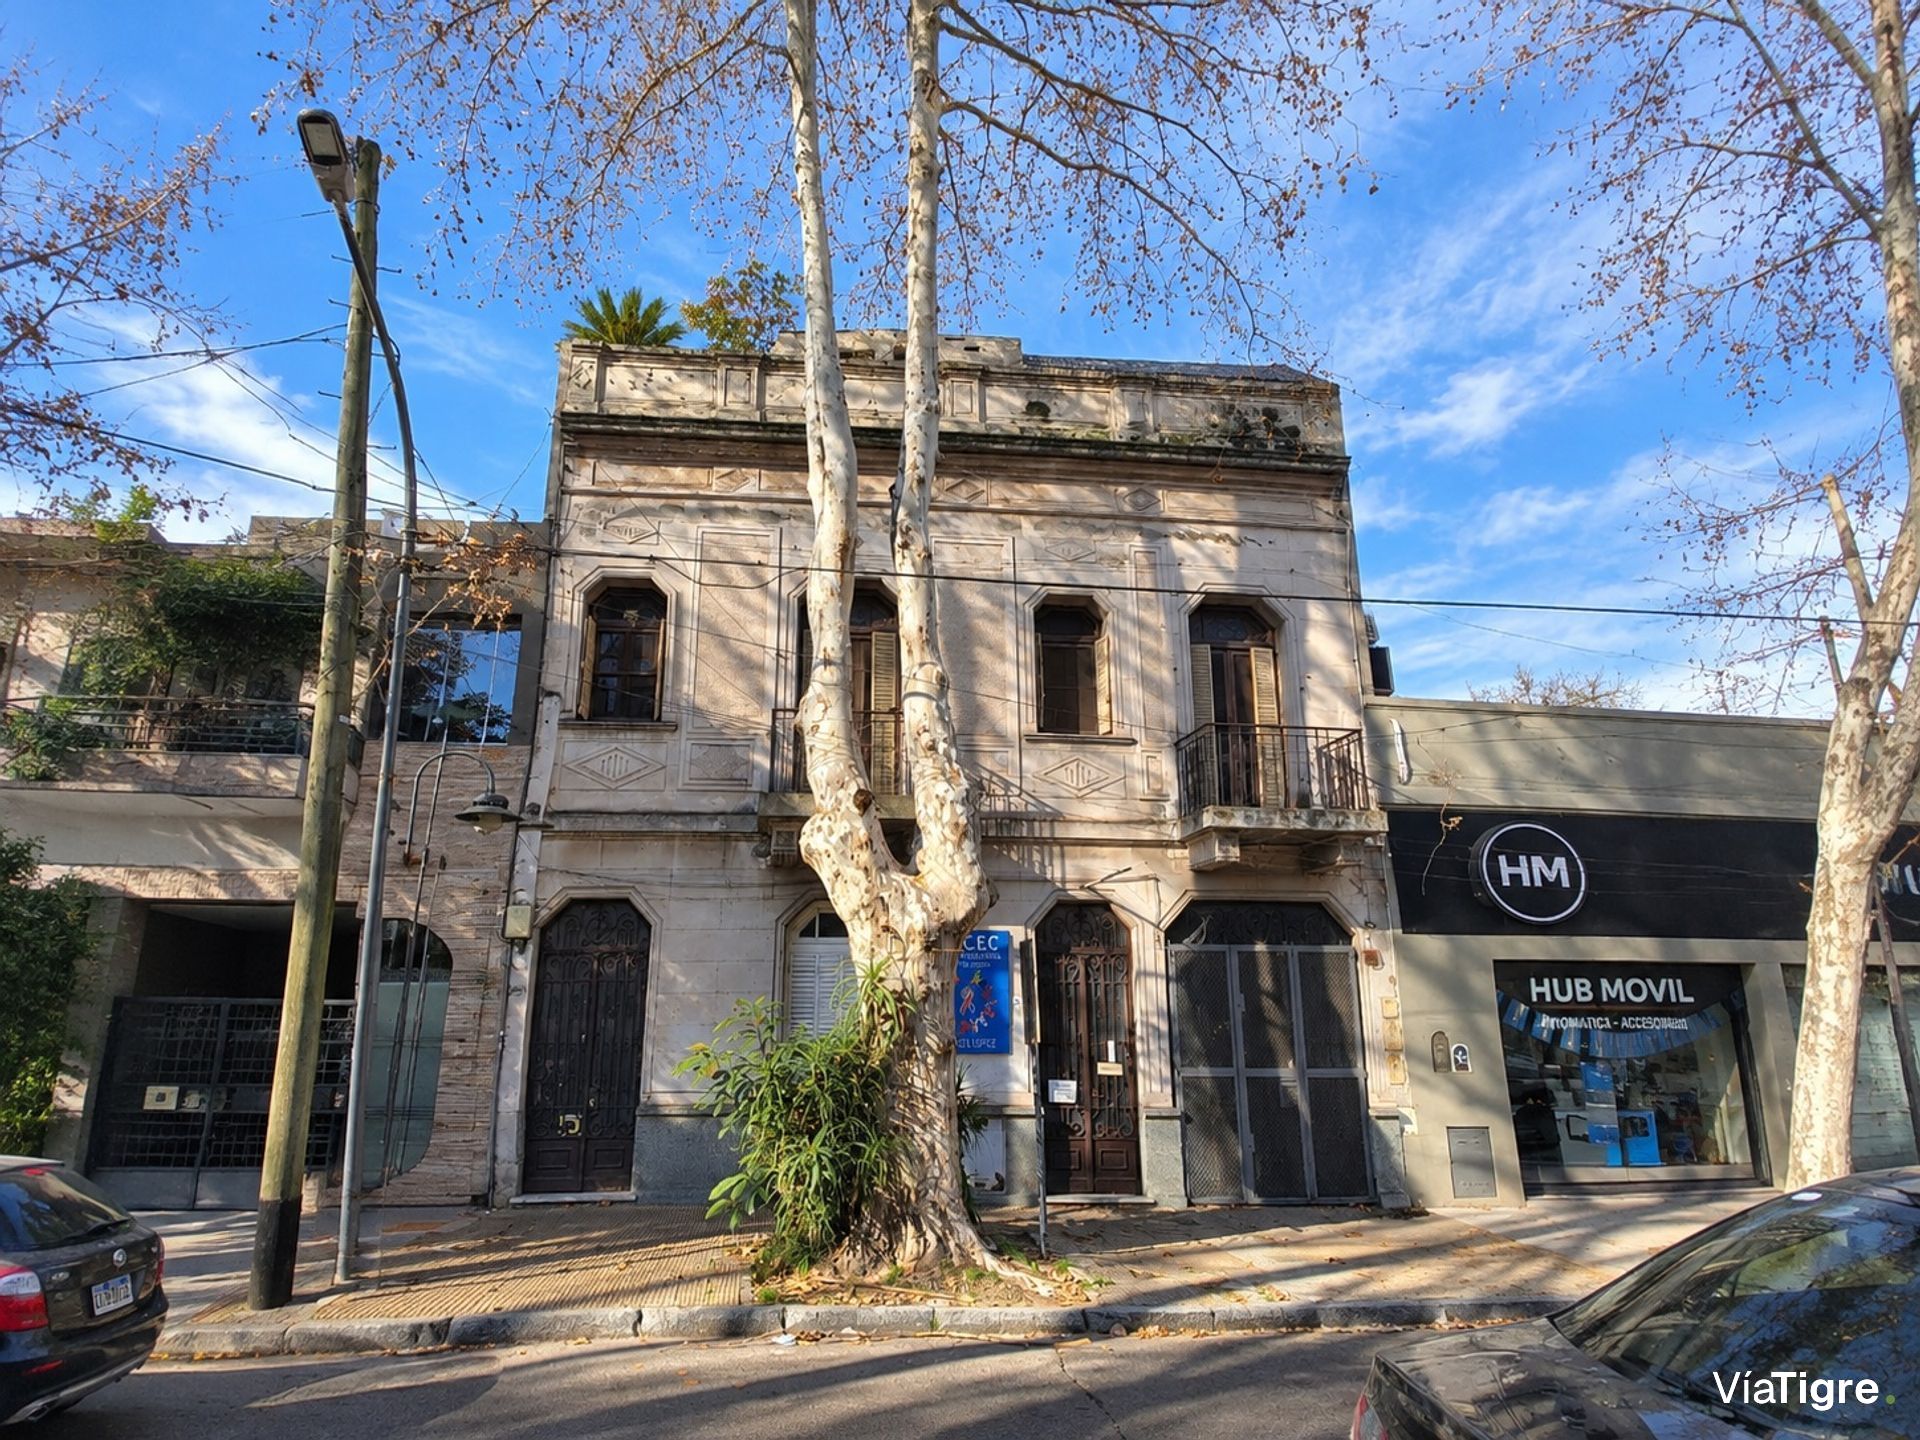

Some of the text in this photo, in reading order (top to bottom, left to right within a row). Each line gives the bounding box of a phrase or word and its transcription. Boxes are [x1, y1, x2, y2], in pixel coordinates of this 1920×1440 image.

[1498, 855, 1570, 888] HM
[963, 935, 999, 951] CEC
[1529, 977, 1695, 1003] HUB MOVIL
